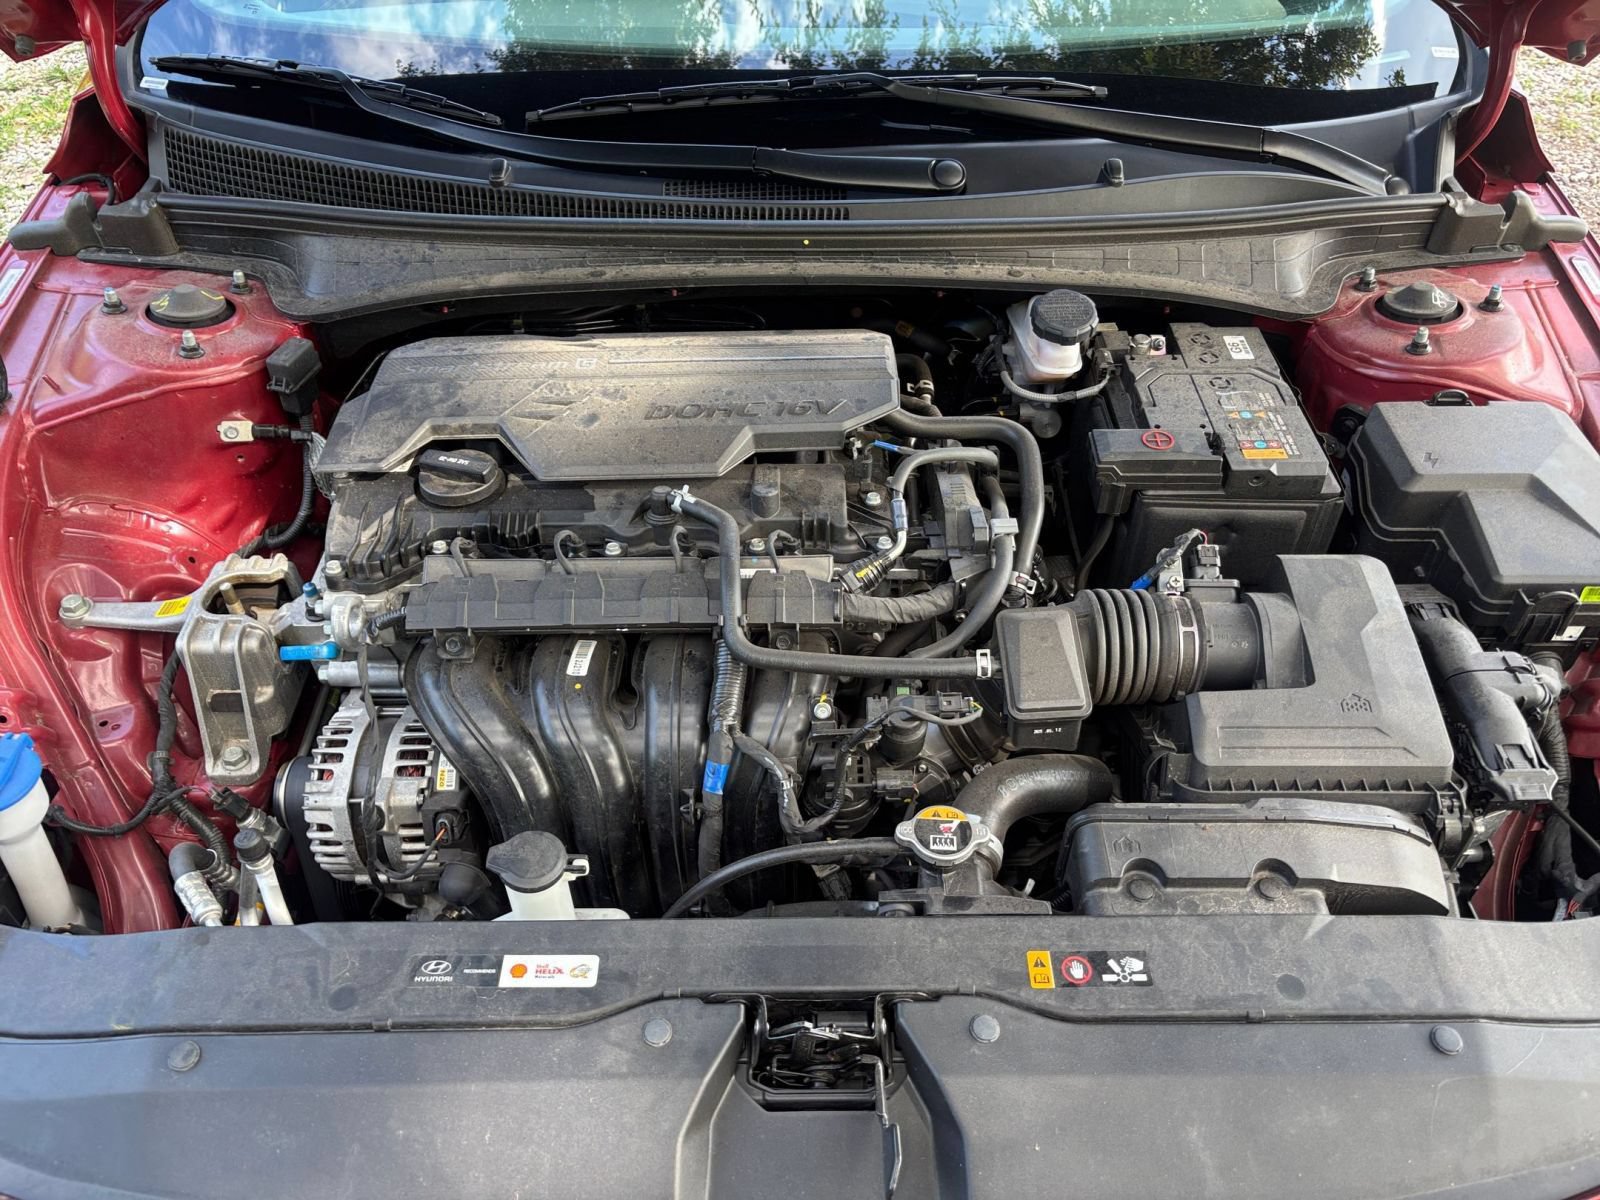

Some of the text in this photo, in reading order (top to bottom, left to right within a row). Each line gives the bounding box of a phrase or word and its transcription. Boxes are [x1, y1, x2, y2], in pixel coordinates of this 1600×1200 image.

[644, 399, 848, 420] DOHC 16V
[535, 967, 564, 975] HELIX
